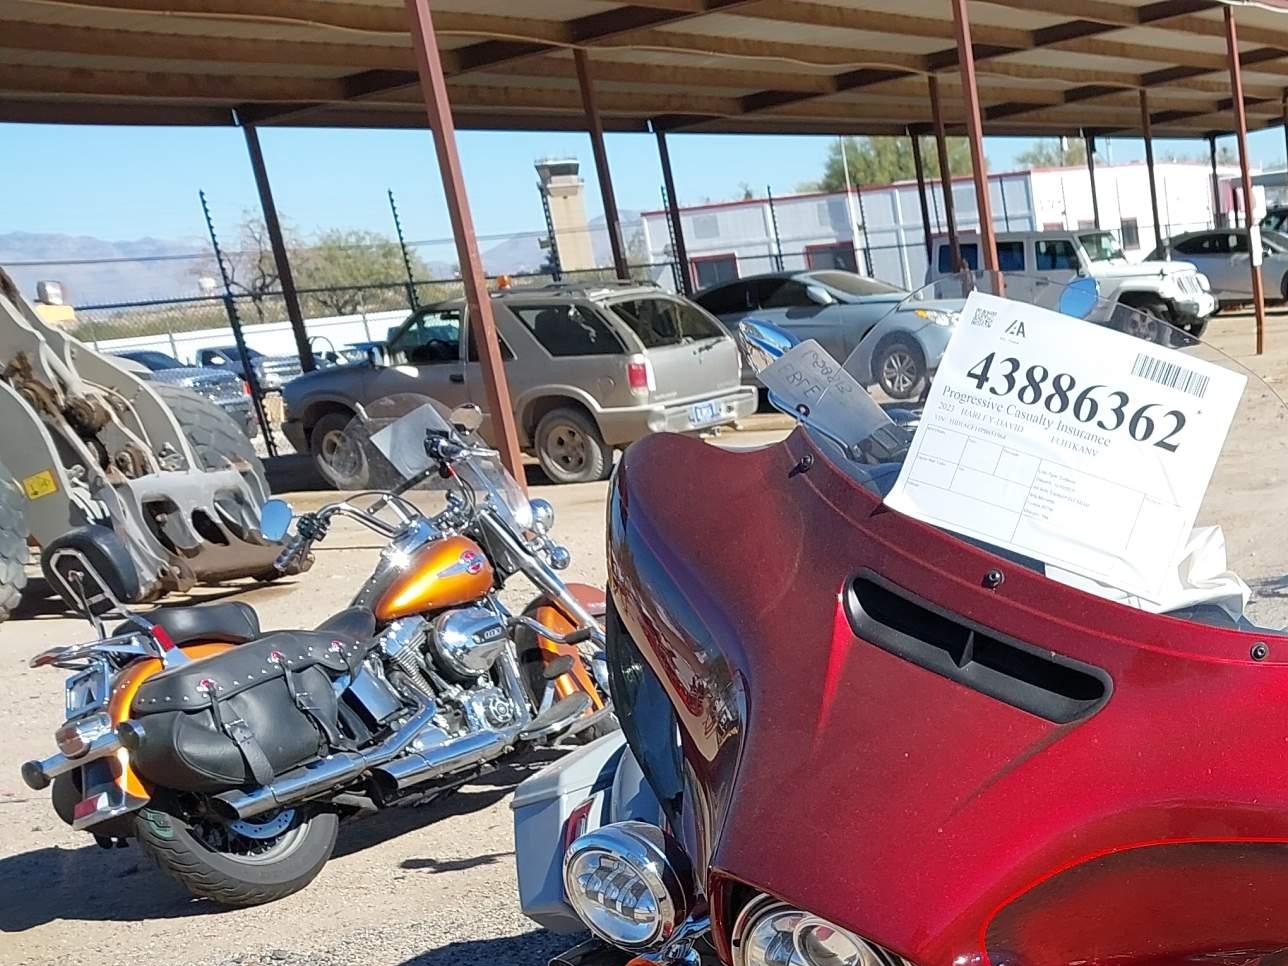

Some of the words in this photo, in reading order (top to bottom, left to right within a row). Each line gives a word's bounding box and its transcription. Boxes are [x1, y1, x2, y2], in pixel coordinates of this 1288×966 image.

[943, 384, 1005, 413] Progressive
[1005, 403, 1055, 431] Casualty
[1056, 419, 1112, 448] Insurance
[966, 352, 1187, 454] 43886362
